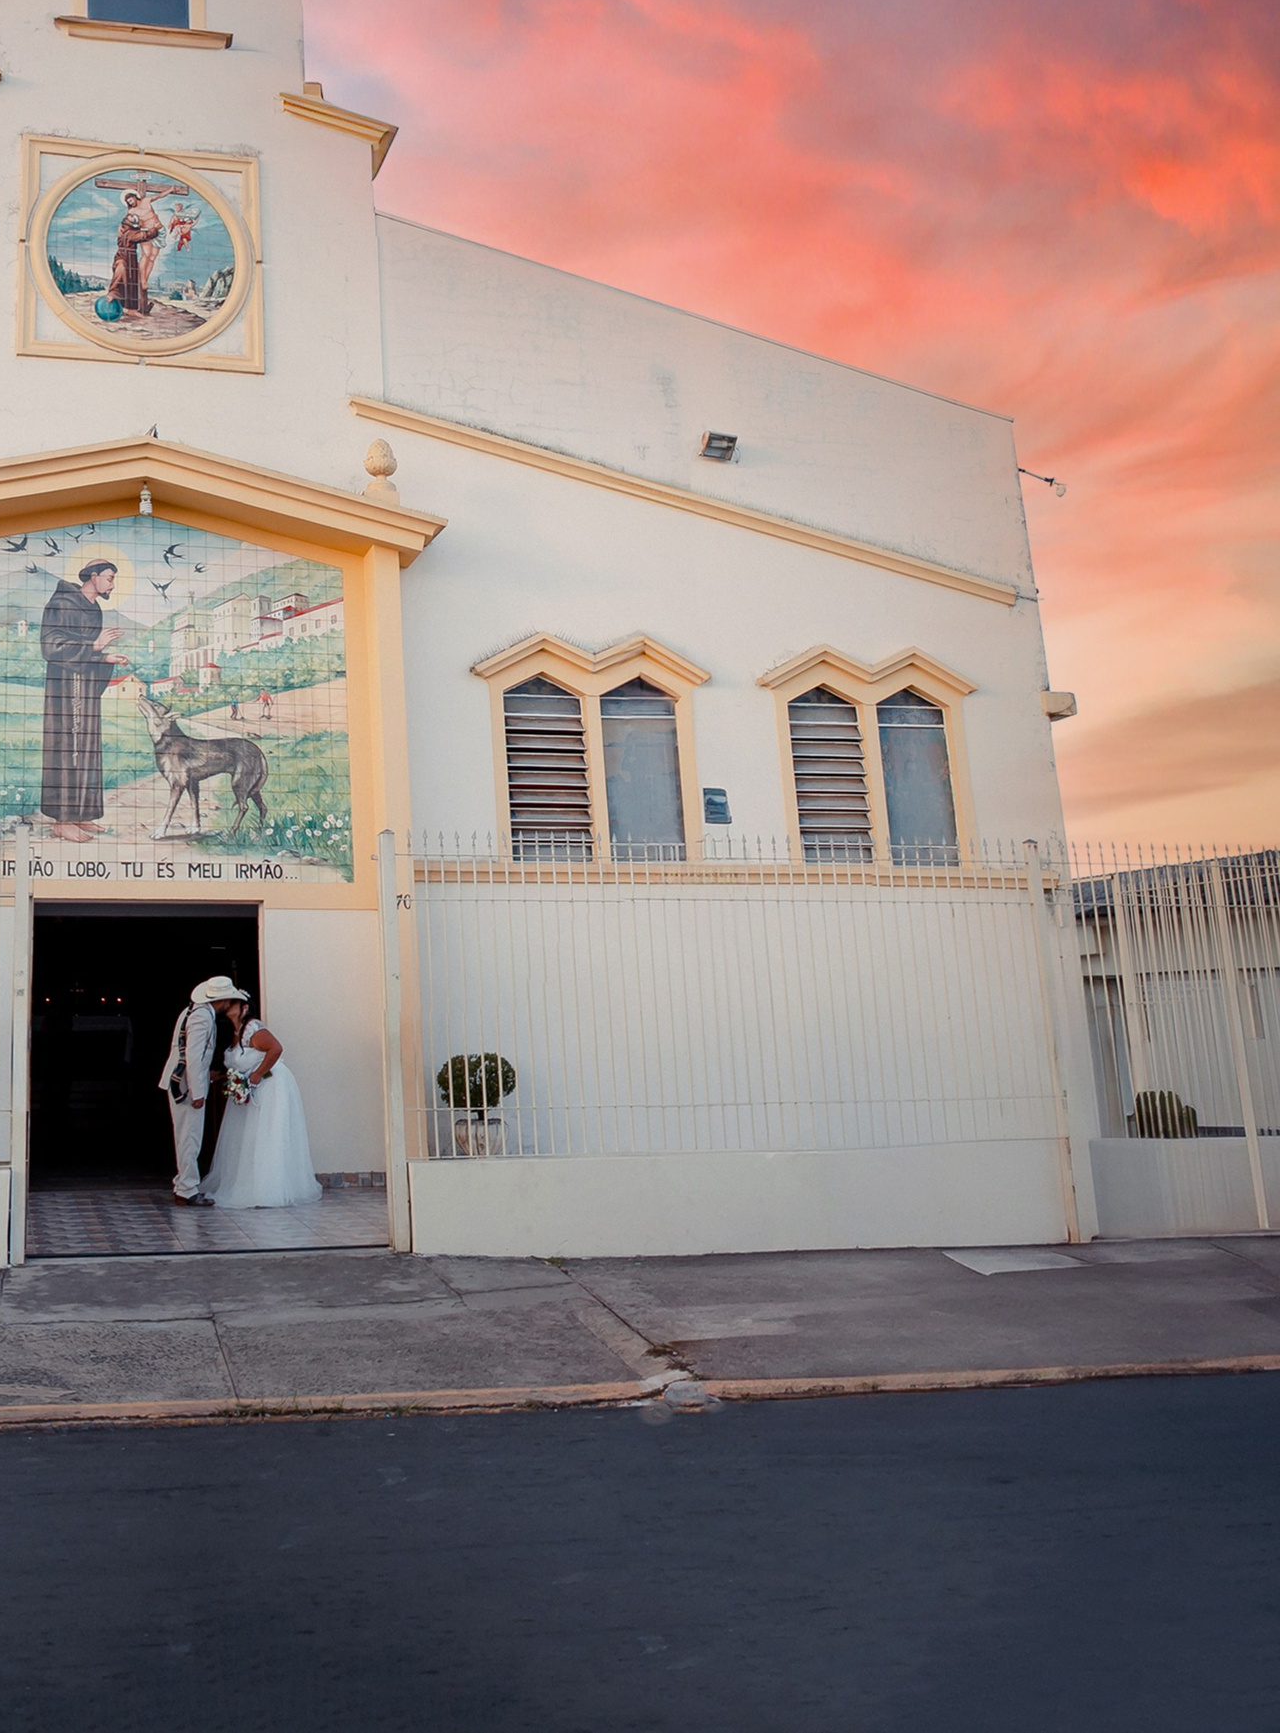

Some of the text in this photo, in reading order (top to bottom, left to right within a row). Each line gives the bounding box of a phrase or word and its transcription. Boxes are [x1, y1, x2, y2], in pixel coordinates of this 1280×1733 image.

[2, 856, 298, 880] IRÃO LOBO, TU ÉS MEU IRMÃO...
